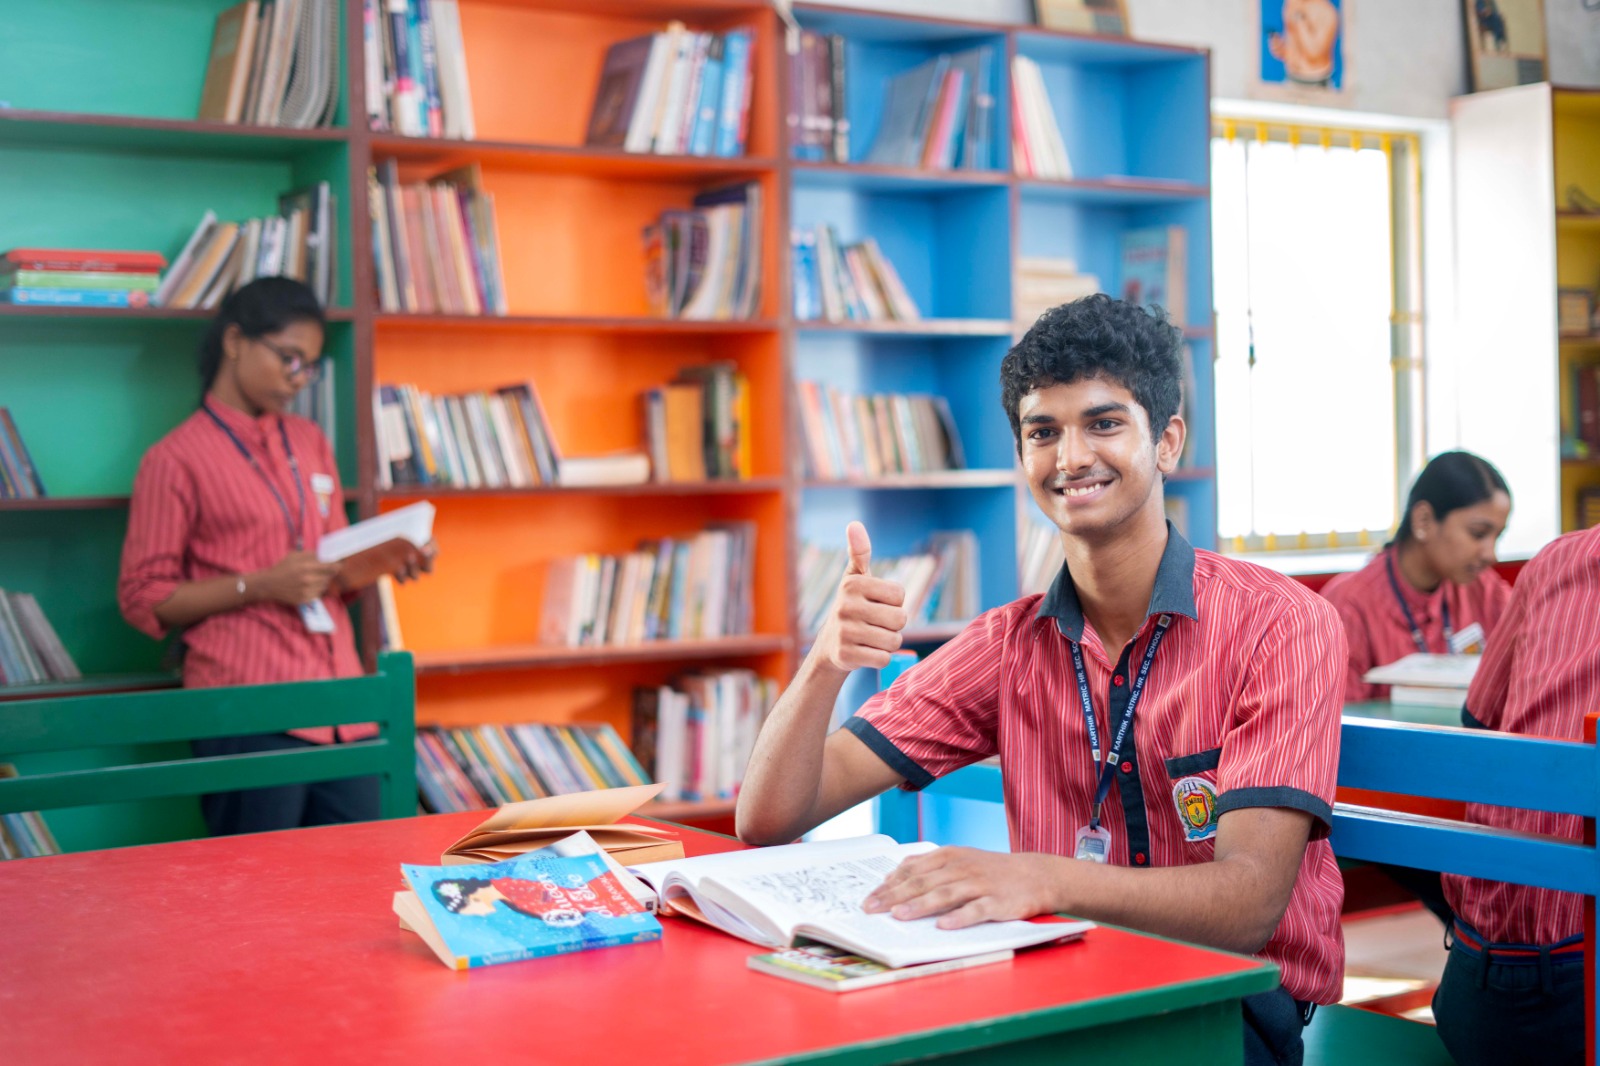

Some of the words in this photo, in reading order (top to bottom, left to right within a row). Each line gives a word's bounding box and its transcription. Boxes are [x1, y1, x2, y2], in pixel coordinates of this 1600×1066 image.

[1077, 671, 1087, 683] HR.
[1113, 720, 1129, 751] KARTHIK
[1125, 690, 1141, 718] MATRIC.
[1136, 676, 1146, 689] HR.
[1141, 660, 1151, 674] SEC.
[1146, 630, 1163, 658] SCHOOL
[1080, 684, 1092, 712] MATRIC.
[1087, 715, 1099, 747] KARTHIK
[537, 873, 585, 927] Queen
